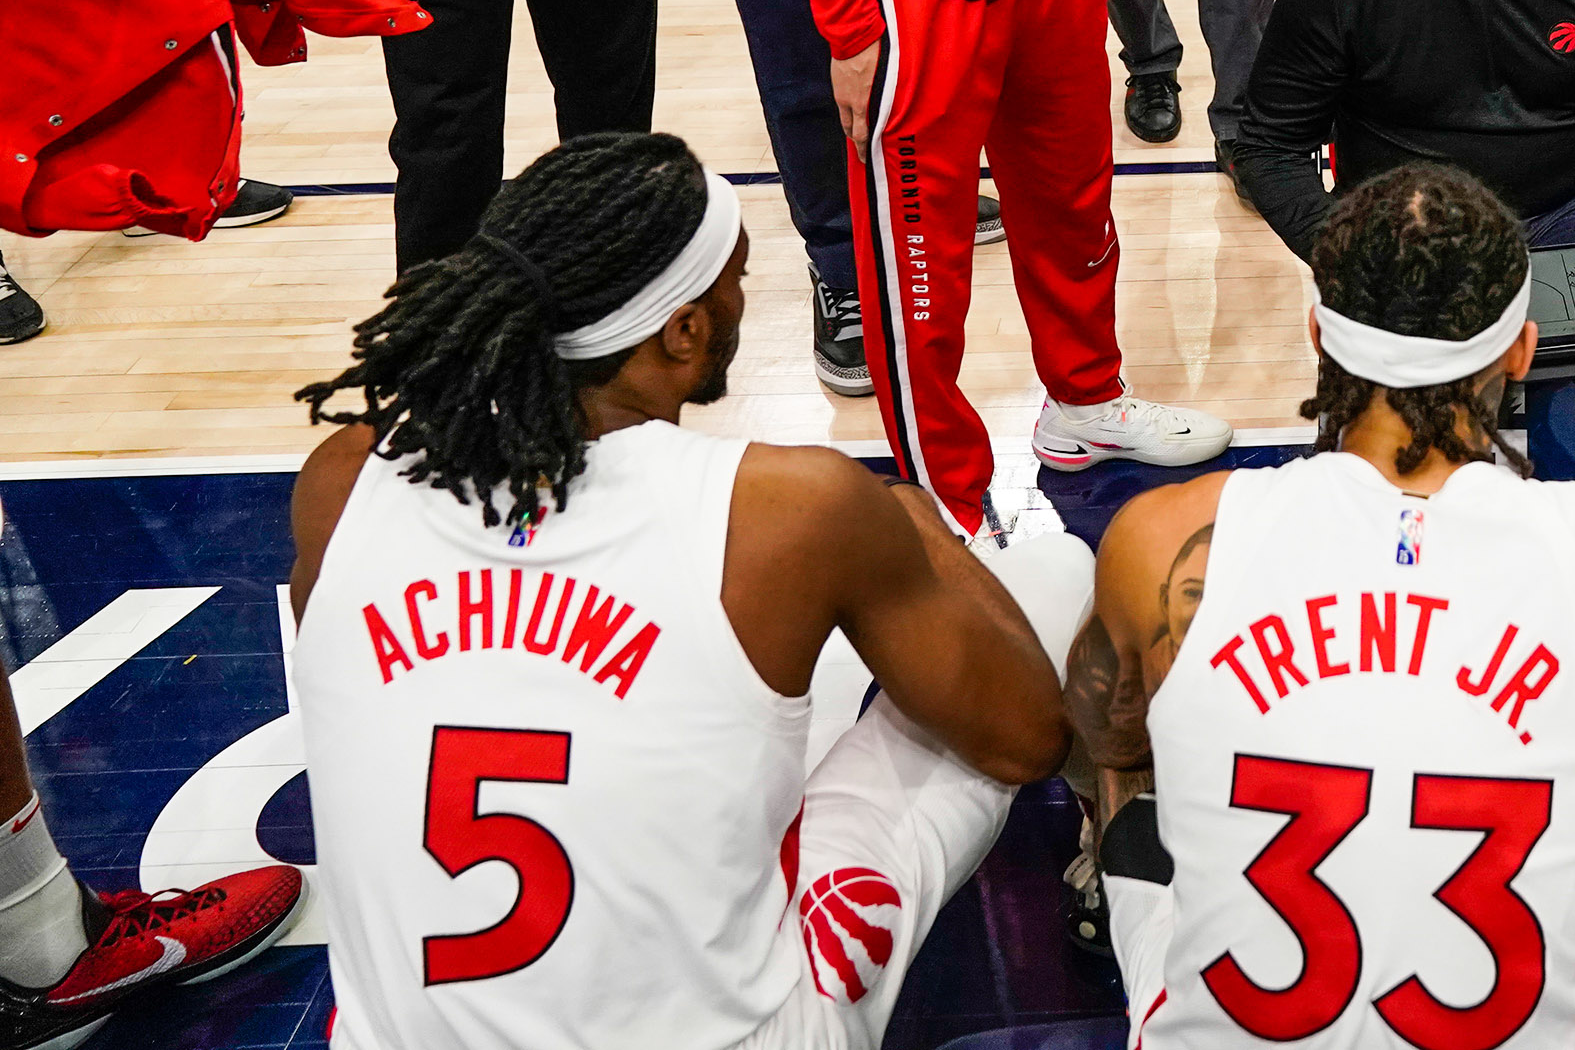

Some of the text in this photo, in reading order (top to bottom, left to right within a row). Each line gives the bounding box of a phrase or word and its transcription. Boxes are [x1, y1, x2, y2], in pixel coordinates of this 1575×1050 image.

[898, 134, 930, 321] TORONTO RAPTORS
[362, 568, 662, 701] ACHIUWA
[1209, 592, 1561, 747] TRENT JR.
[422, 724, 576, 988] 5
[1199, 752, 1555, 1050] 33
